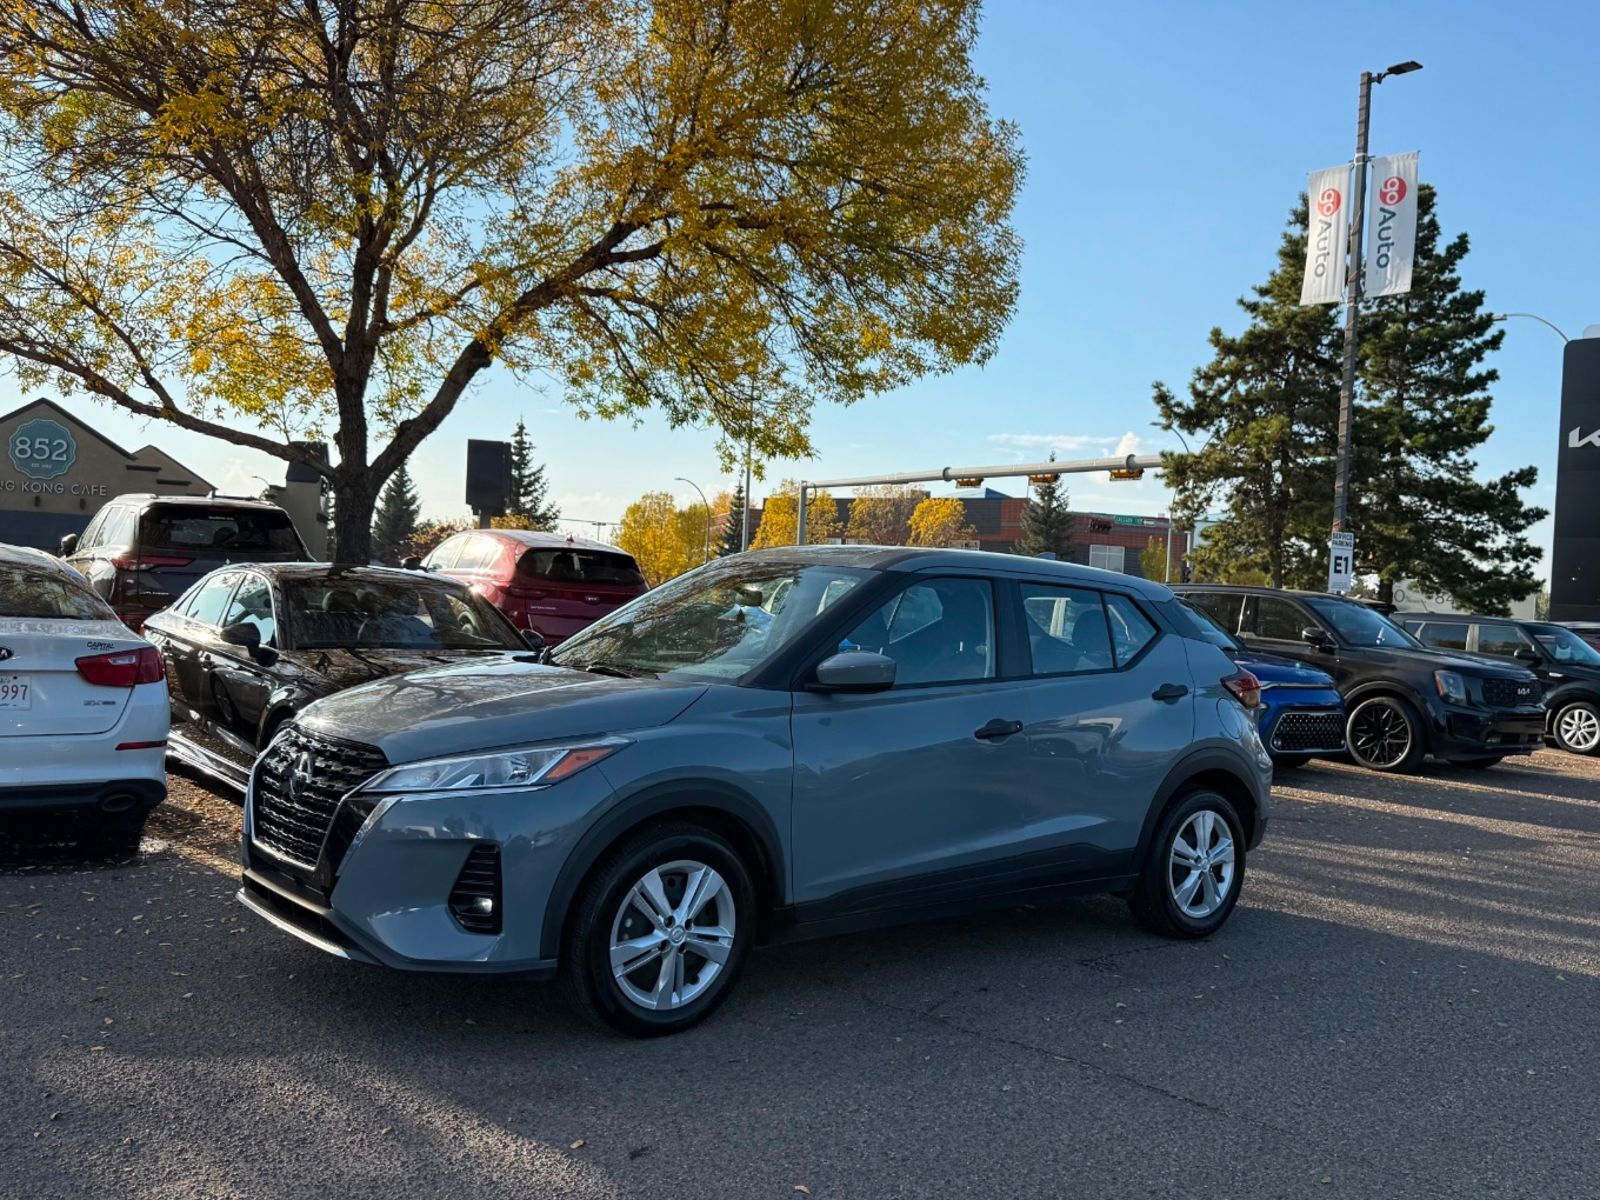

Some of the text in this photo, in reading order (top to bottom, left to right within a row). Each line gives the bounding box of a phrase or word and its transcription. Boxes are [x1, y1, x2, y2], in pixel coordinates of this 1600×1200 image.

[1376, 178, 1399, 269] go Auto
[1314, 219, 1332, 277] Auto
[15, 436, 68, 461] 852
[21, 481, 65, 494] KONG
[71, 483, 107, 496] CAFE
[1334, 555, 1349, 574] E1
[87, 641, 116, 649] CAPITAL
[1, 684, 28, 700] 997
